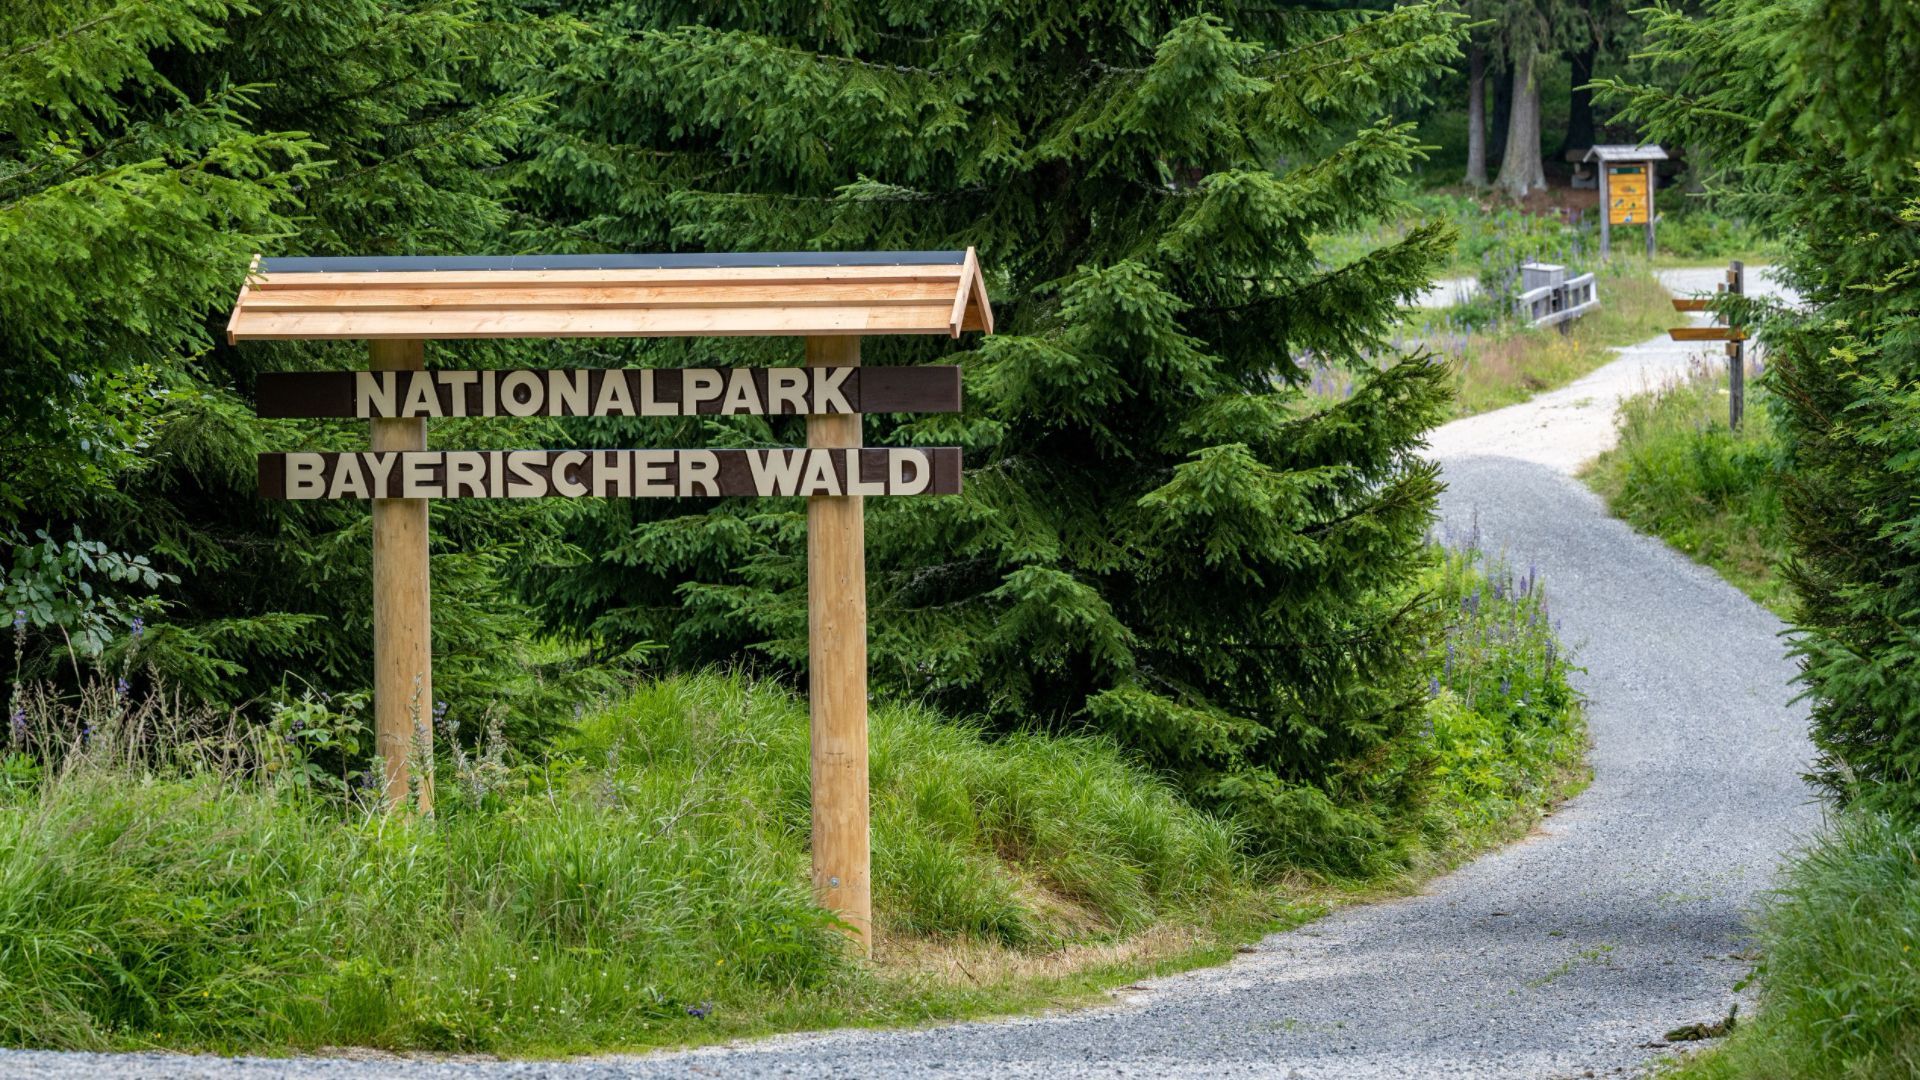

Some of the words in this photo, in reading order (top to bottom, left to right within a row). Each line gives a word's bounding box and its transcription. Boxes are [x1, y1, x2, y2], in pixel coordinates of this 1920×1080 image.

[356, 368, 855, 418] NATIONALPARK
[286, 450, 721, 499] BAYERISCHER
[745, 448, 931, 496] WALD
